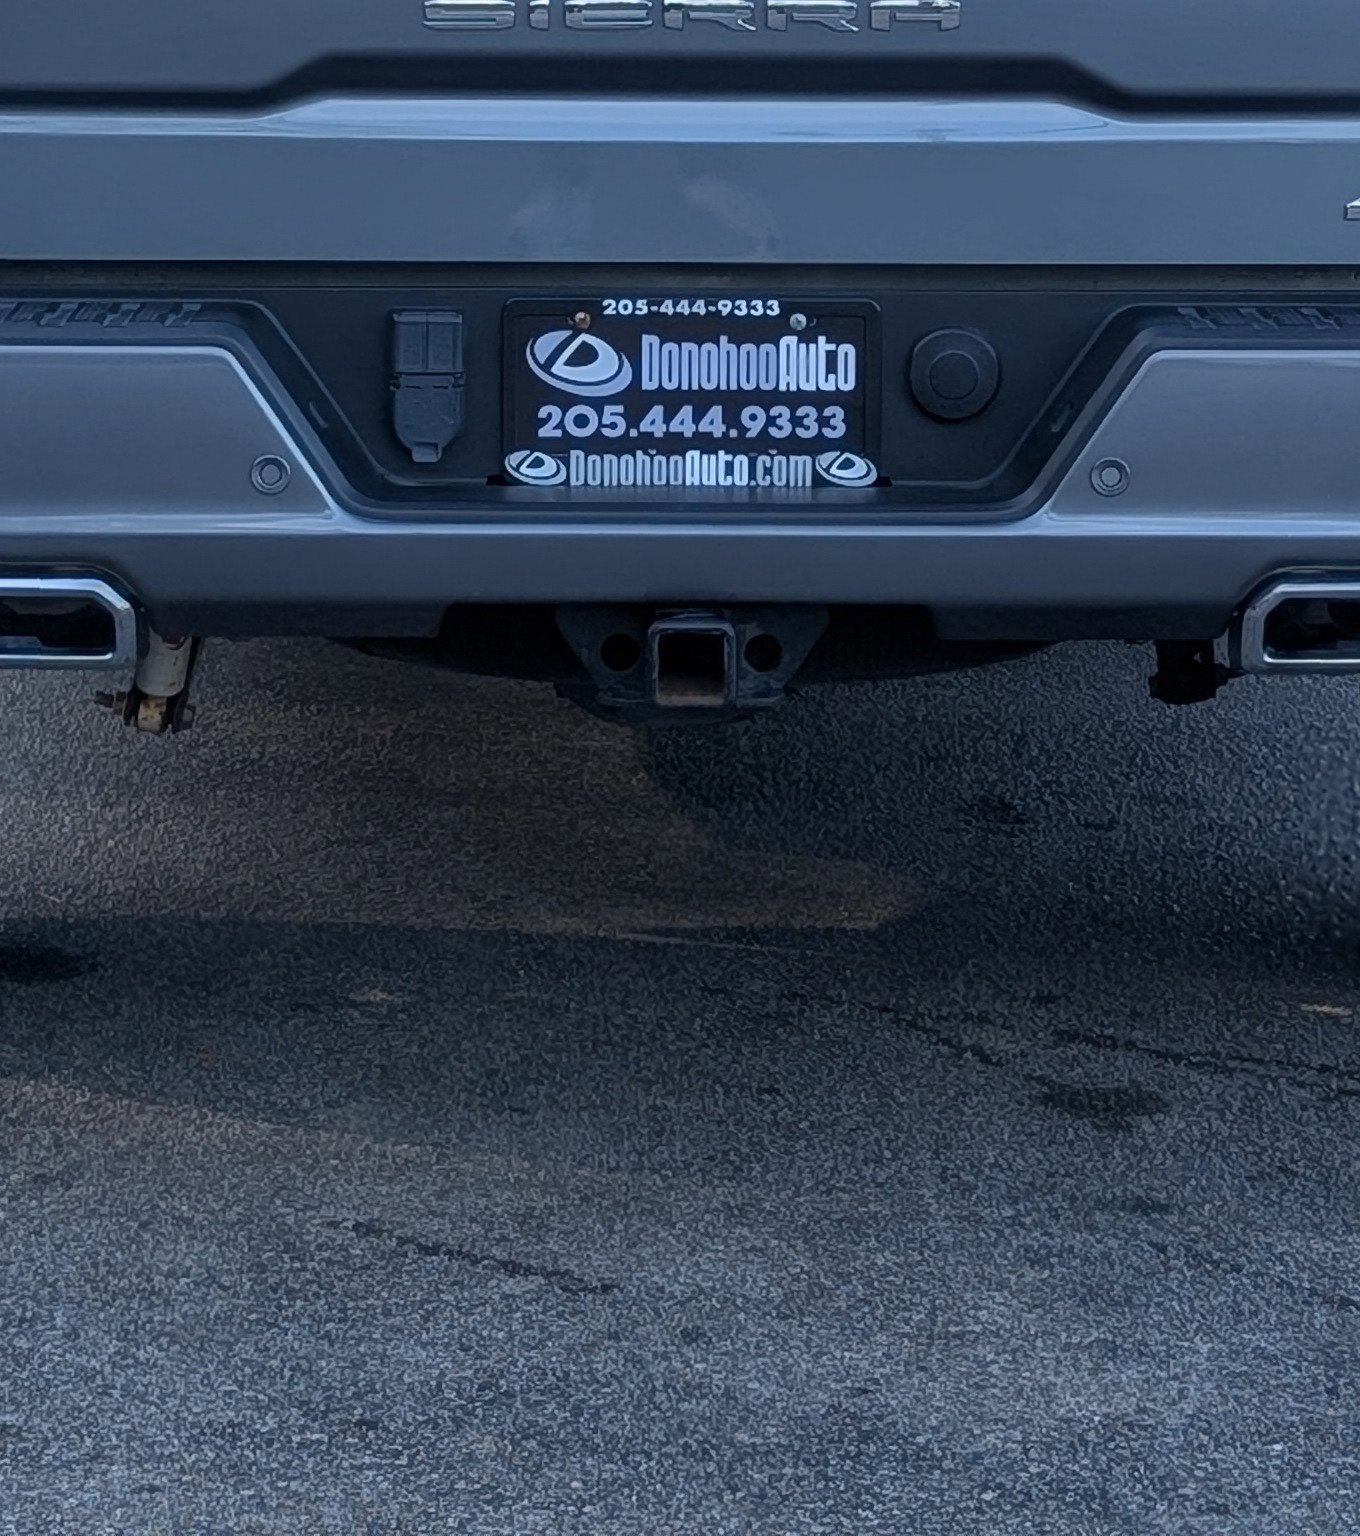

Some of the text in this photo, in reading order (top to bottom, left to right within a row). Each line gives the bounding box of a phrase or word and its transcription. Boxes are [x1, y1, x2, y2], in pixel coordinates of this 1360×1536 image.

[602, 299, 781, 316] 205-444-9333
[641, 334, 856, 392] DonohooAuto
[537, 404, 847, 439] 205.444.9333
[569, 449, 813, 487] DonohooAuto.com
